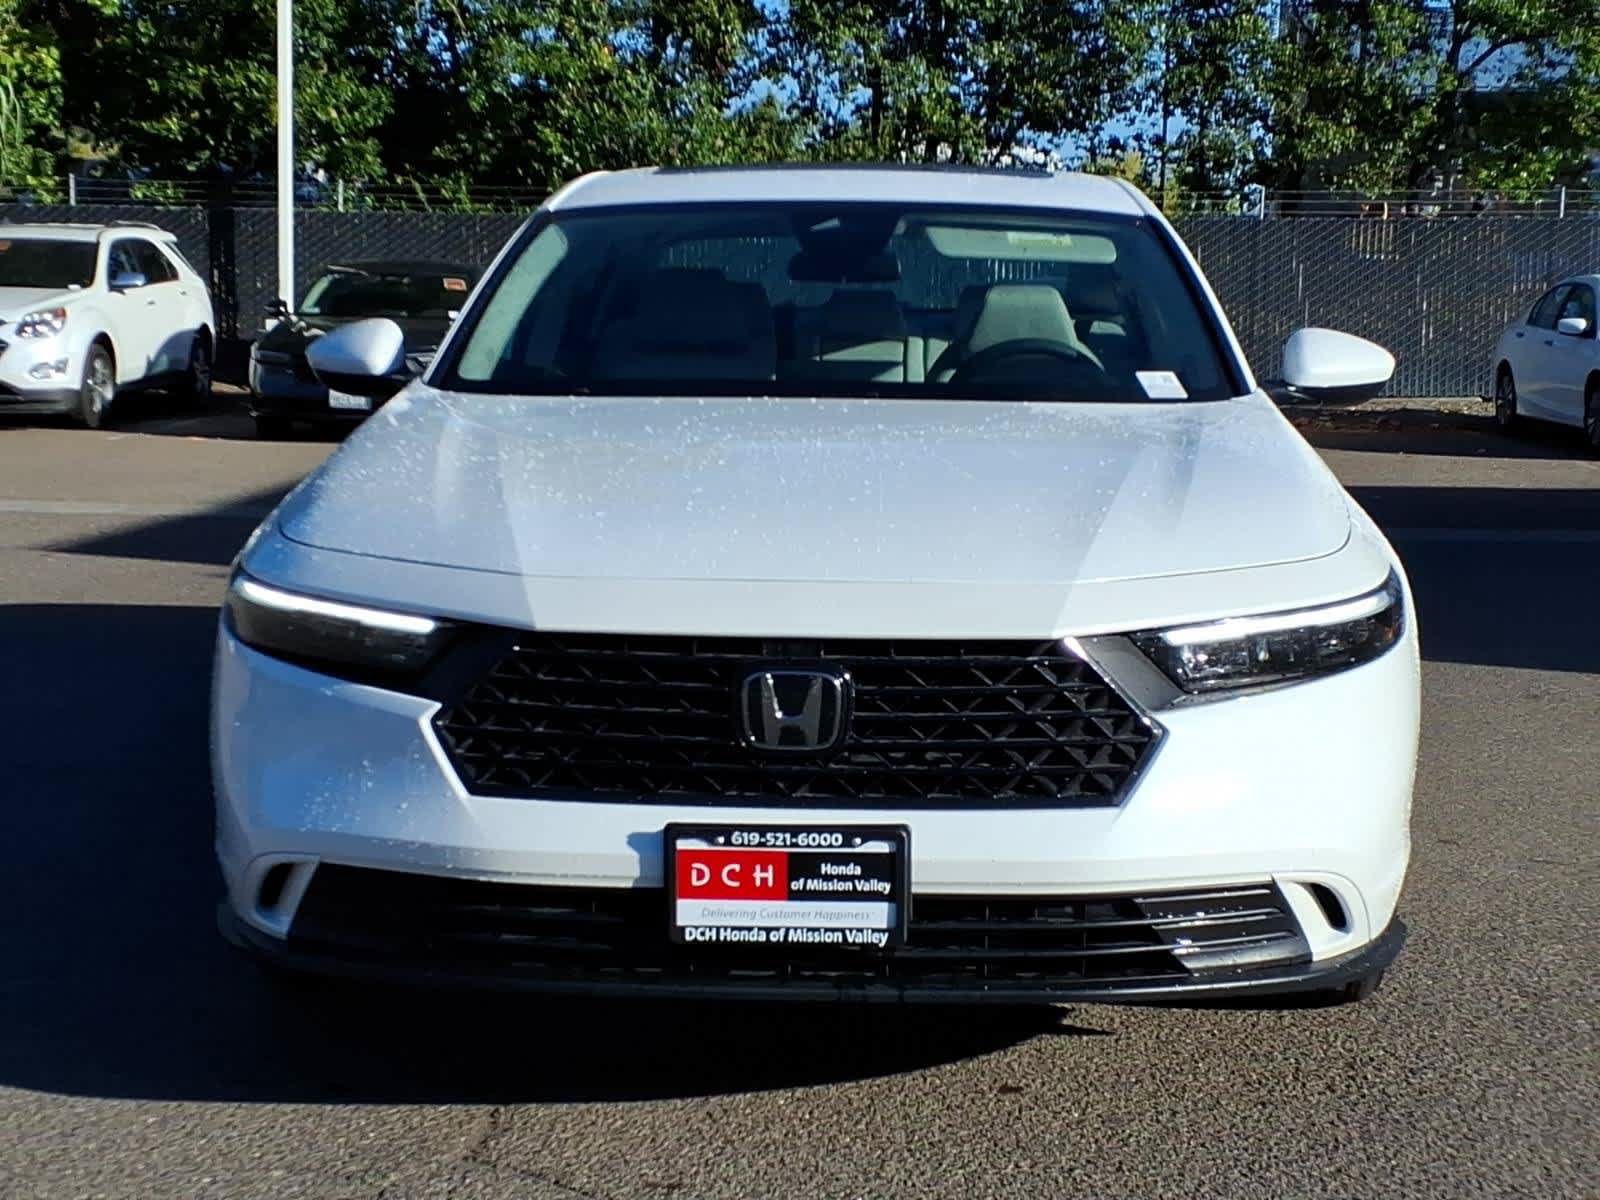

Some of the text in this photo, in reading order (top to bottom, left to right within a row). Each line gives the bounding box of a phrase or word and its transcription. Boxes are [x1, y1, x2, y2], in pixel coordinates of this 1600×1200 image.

[731, 832, 843, 847] 619-521-6000
[820, 863, 862, 876] Honda
[790, 879, 892, 895] of Mission Valley
[701, 907, 871, 922] Delivering Customer Happiness
[684, 927, 889, 948] DCH Honda of Mission Valley
